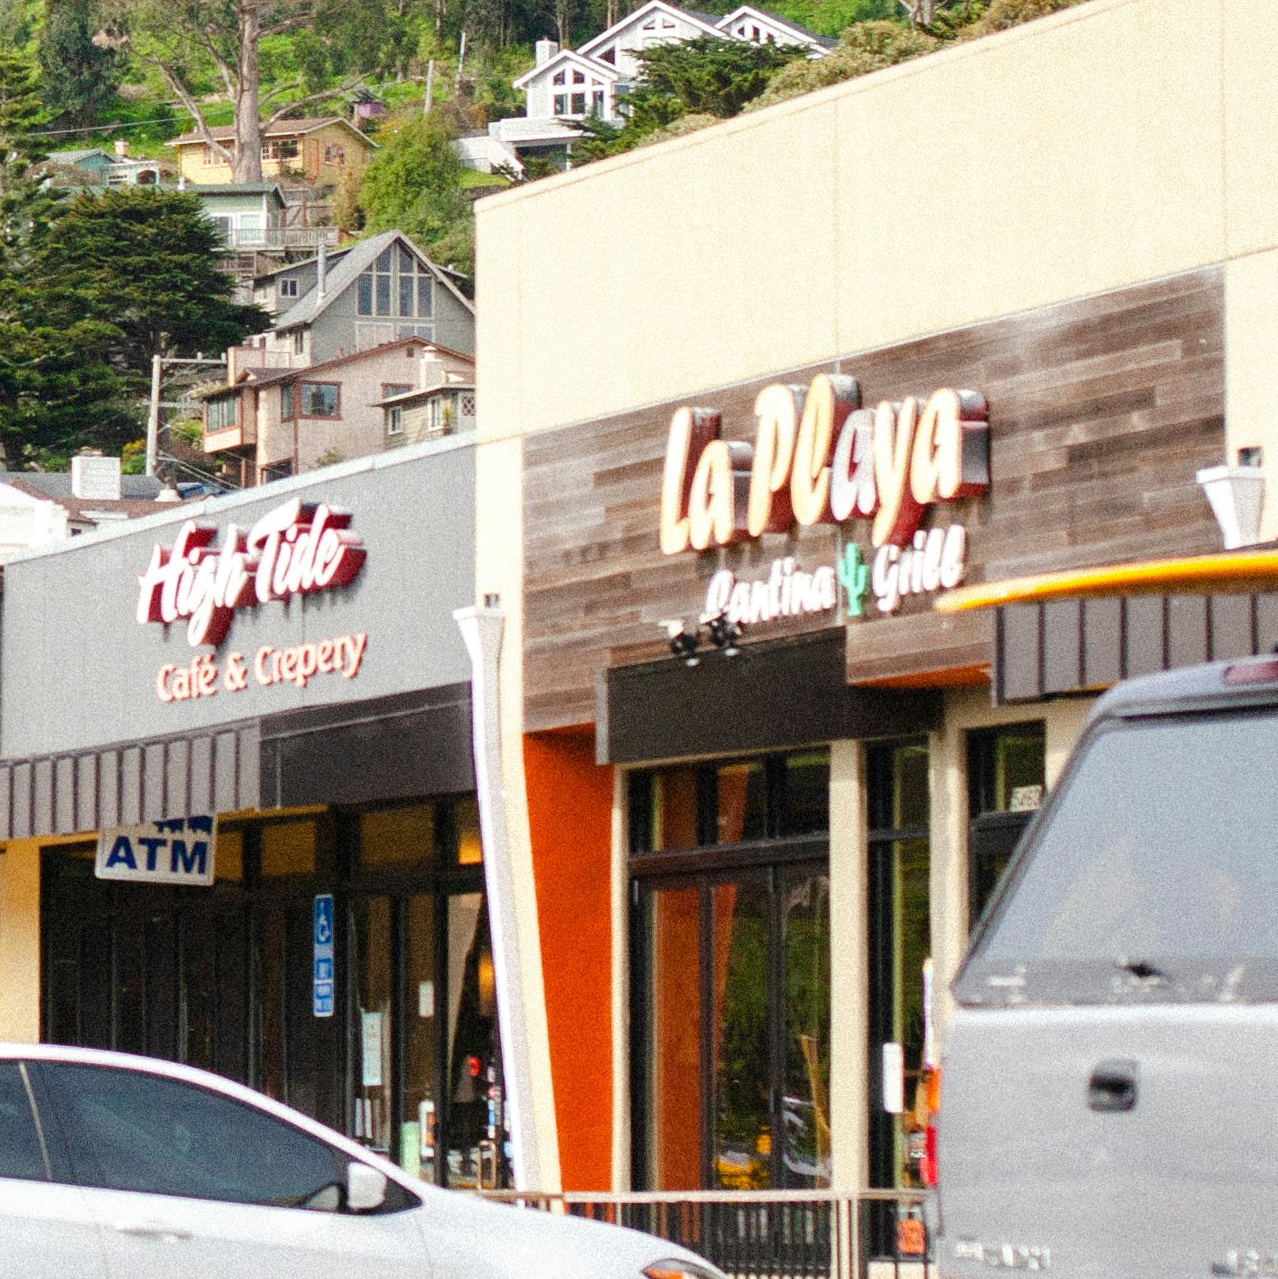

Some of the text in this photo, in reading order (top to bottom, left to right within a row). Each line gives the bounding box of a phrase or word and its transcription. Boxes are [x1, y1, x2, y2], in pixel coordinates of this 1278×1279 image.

[660, 406, 735, 555] La
[136, 497, 351, 647] High Tide
[704, 524, 967, 623] Cantina Grill
[156, 631, 368, 703] Café & Crepery
[105, 835, 208, 875] ATM
